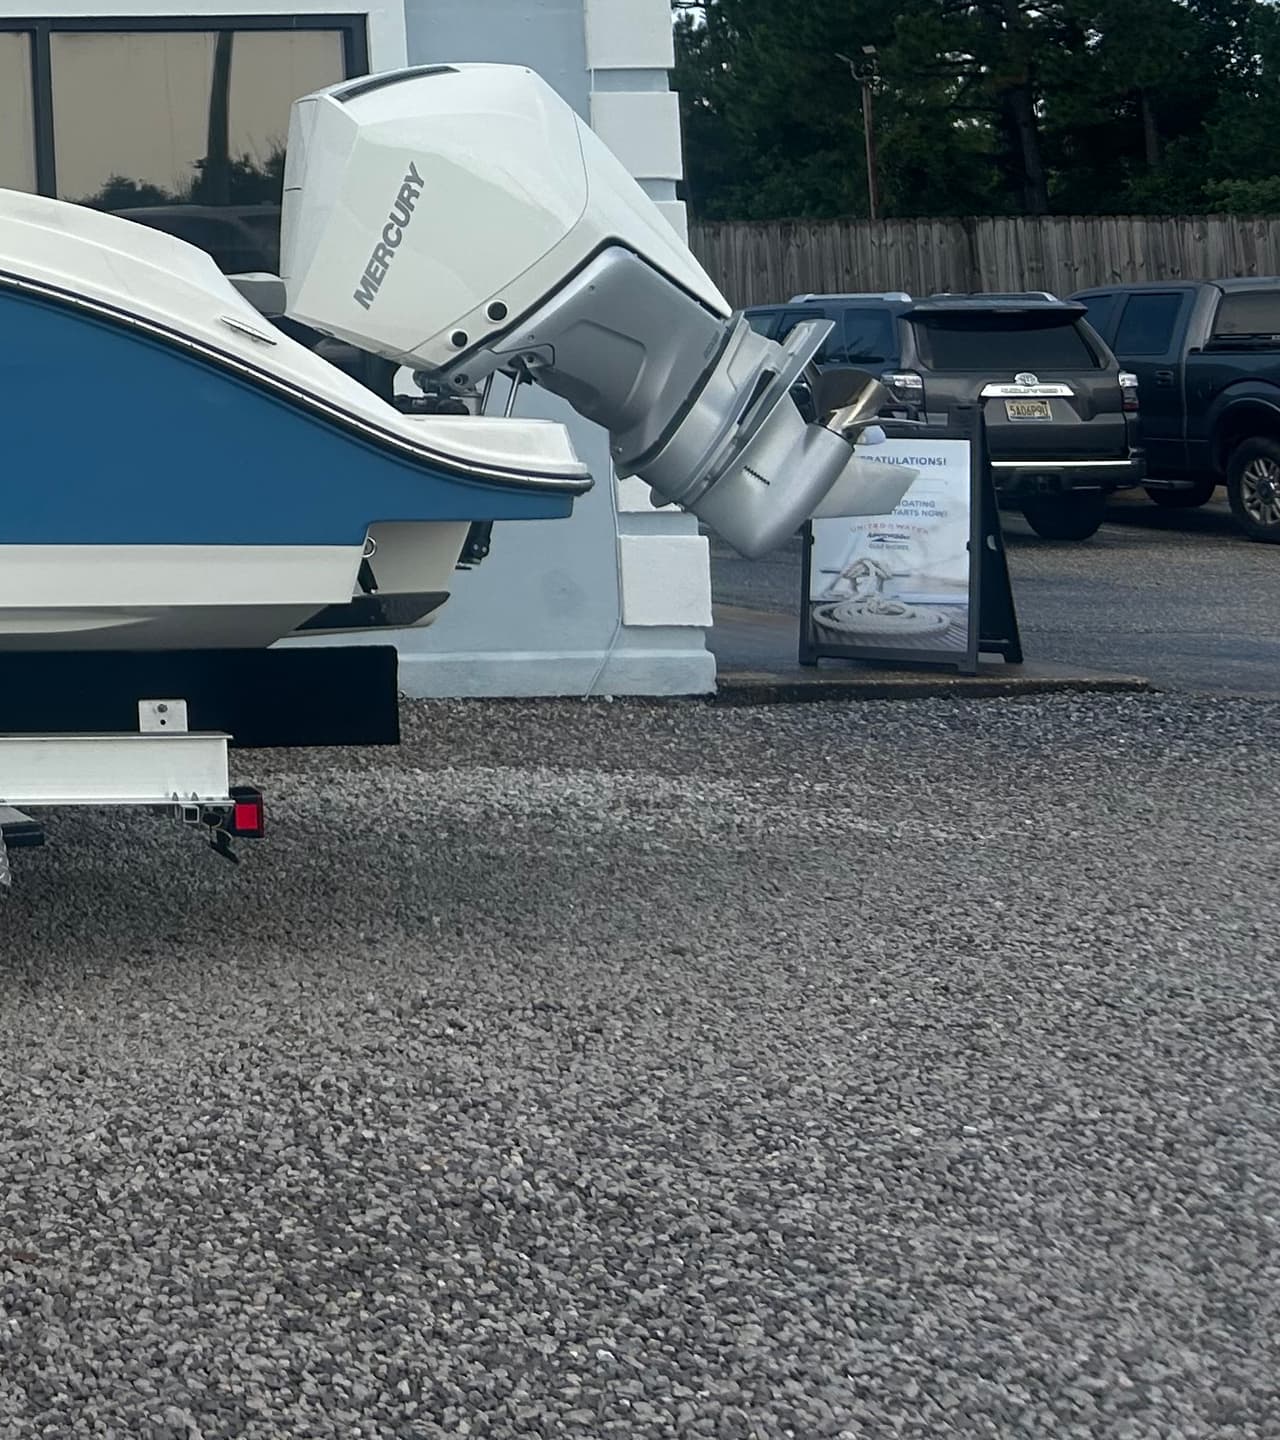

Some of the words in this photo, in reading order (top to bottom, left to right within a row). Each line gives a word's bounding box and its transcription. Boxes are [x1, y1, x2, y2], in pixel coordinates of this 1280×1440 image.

[353, 161, 424, 310] MERCURY
[900, 500, 936, 508] OATING
[893, 508, 920, 516] TARTS
